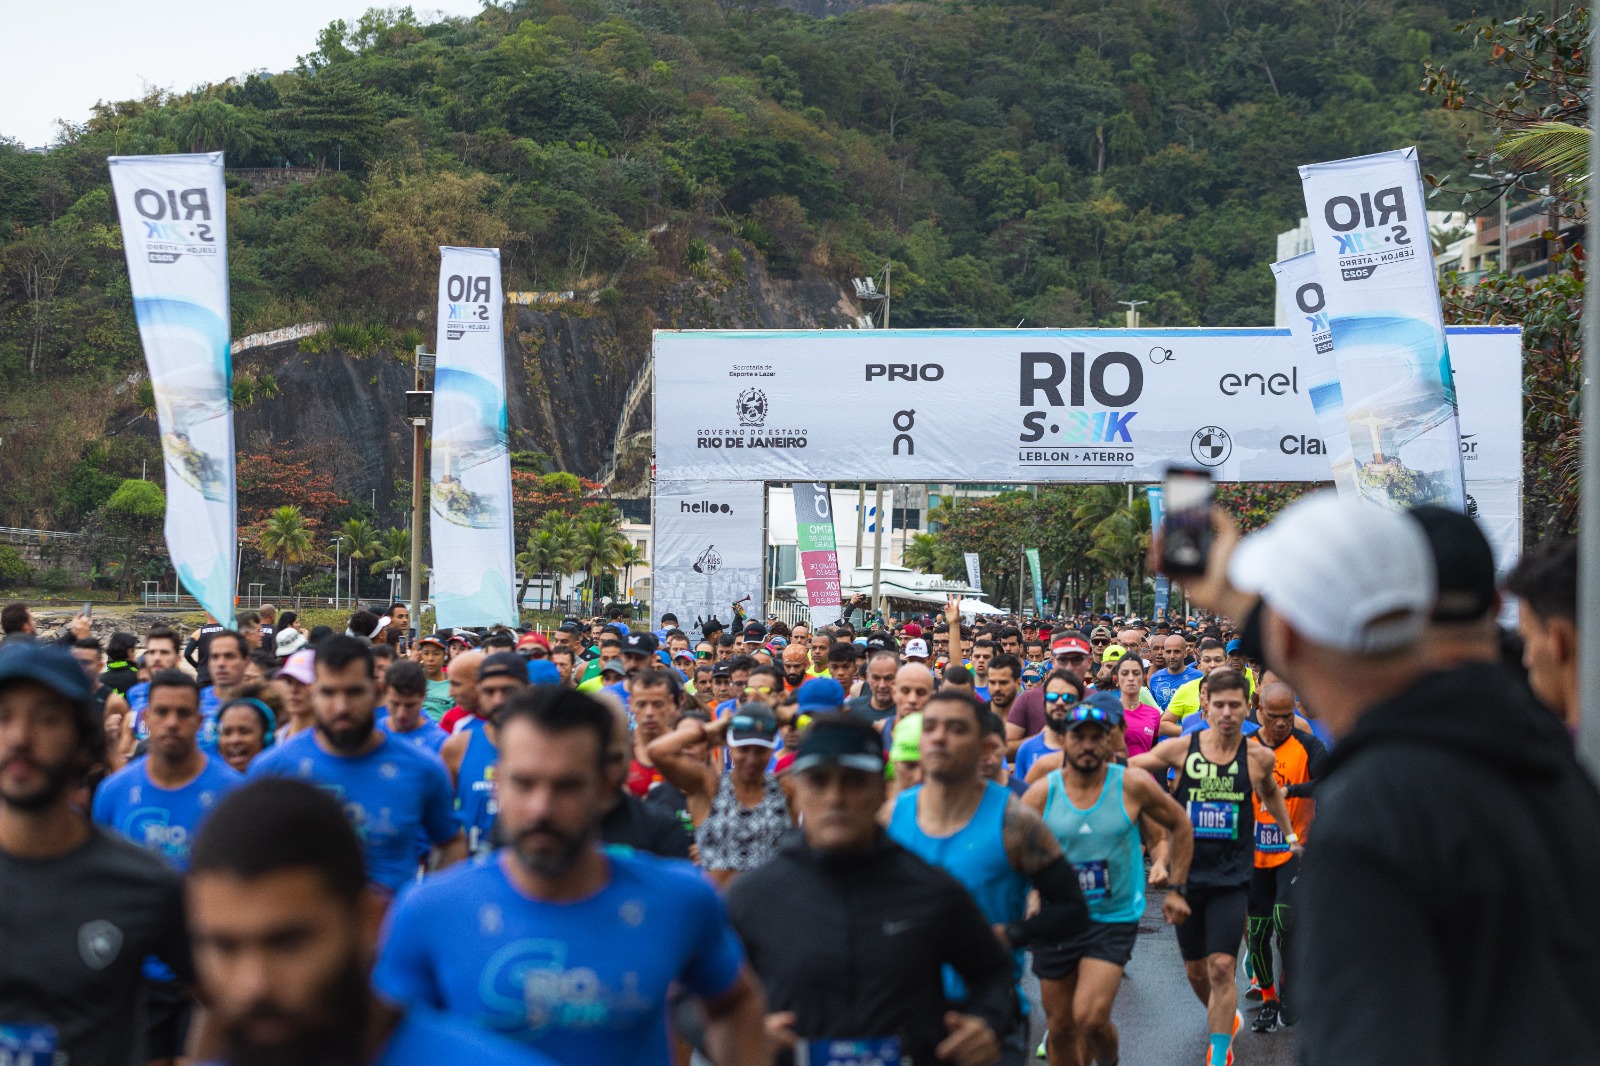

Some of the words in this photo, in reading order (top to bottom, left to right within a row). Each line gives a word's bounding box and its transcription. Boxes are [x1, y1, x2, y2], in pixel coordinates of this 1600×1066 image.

[865, 363, 945, 382] PRIO
[1019, 351, 1144, 408] RIO
[1219, 366, 1299, 396] enel
[1196, 427, 1227, 440] BMW
[697, 437, 722, 449] RIO
[725, 437, 744, 449] DE
[747, 437, 808, 449] JANEIRO
[1018, 451, 1070, 462] LEBLON
[1082, 451, 1135, 462] ATERRO
[1198, 811, 1227, 829] 11015
[1260, 831, 1284, 845] 6841
